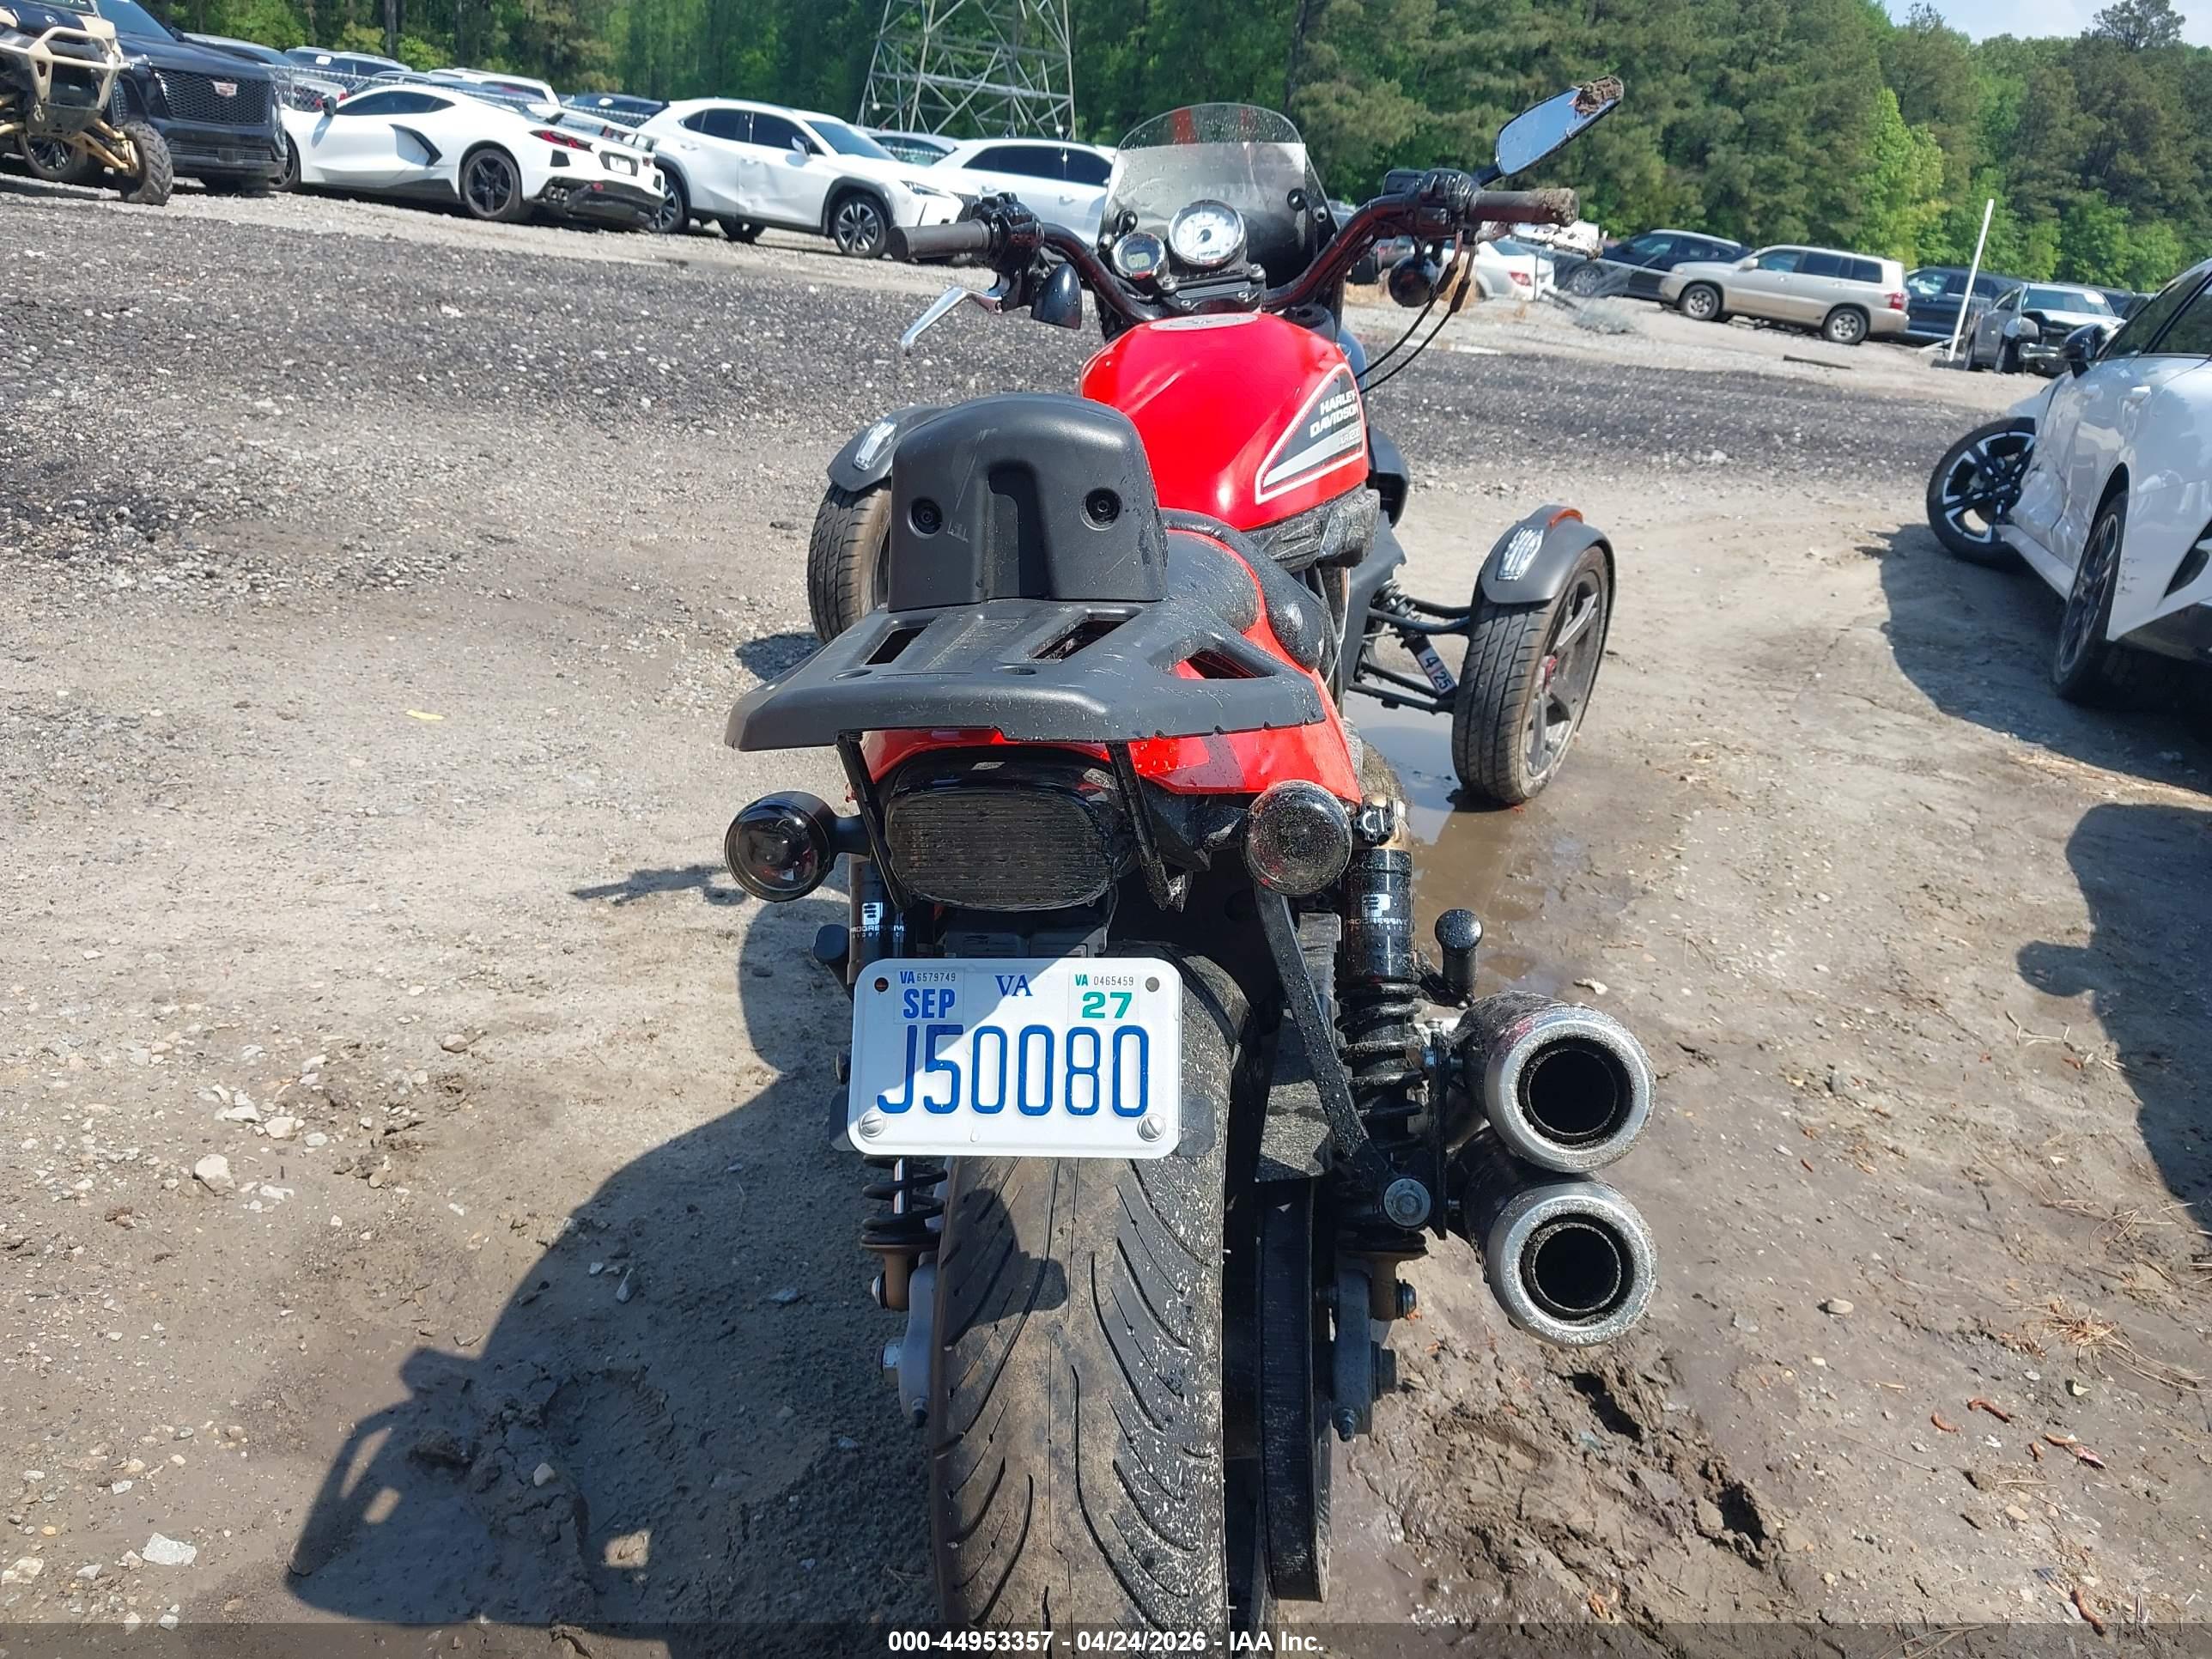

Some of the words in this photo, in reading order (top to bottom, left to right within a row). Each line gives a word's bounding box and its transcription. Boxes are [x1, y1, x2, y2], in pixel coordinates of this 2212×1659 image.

[900, 971, 915, 984] VA
[916, 972, 956, 982] 6579749
[995, 975, 1032, 996] VA
[1075, 974, 1089, 987] VA
[1093, 975, 1134, 987] 0465459
[902, 988, 956, 1019] SEP
[1082, 992, 1133, 1019] 27
[877, 1024, 1149, 1117] J50080
